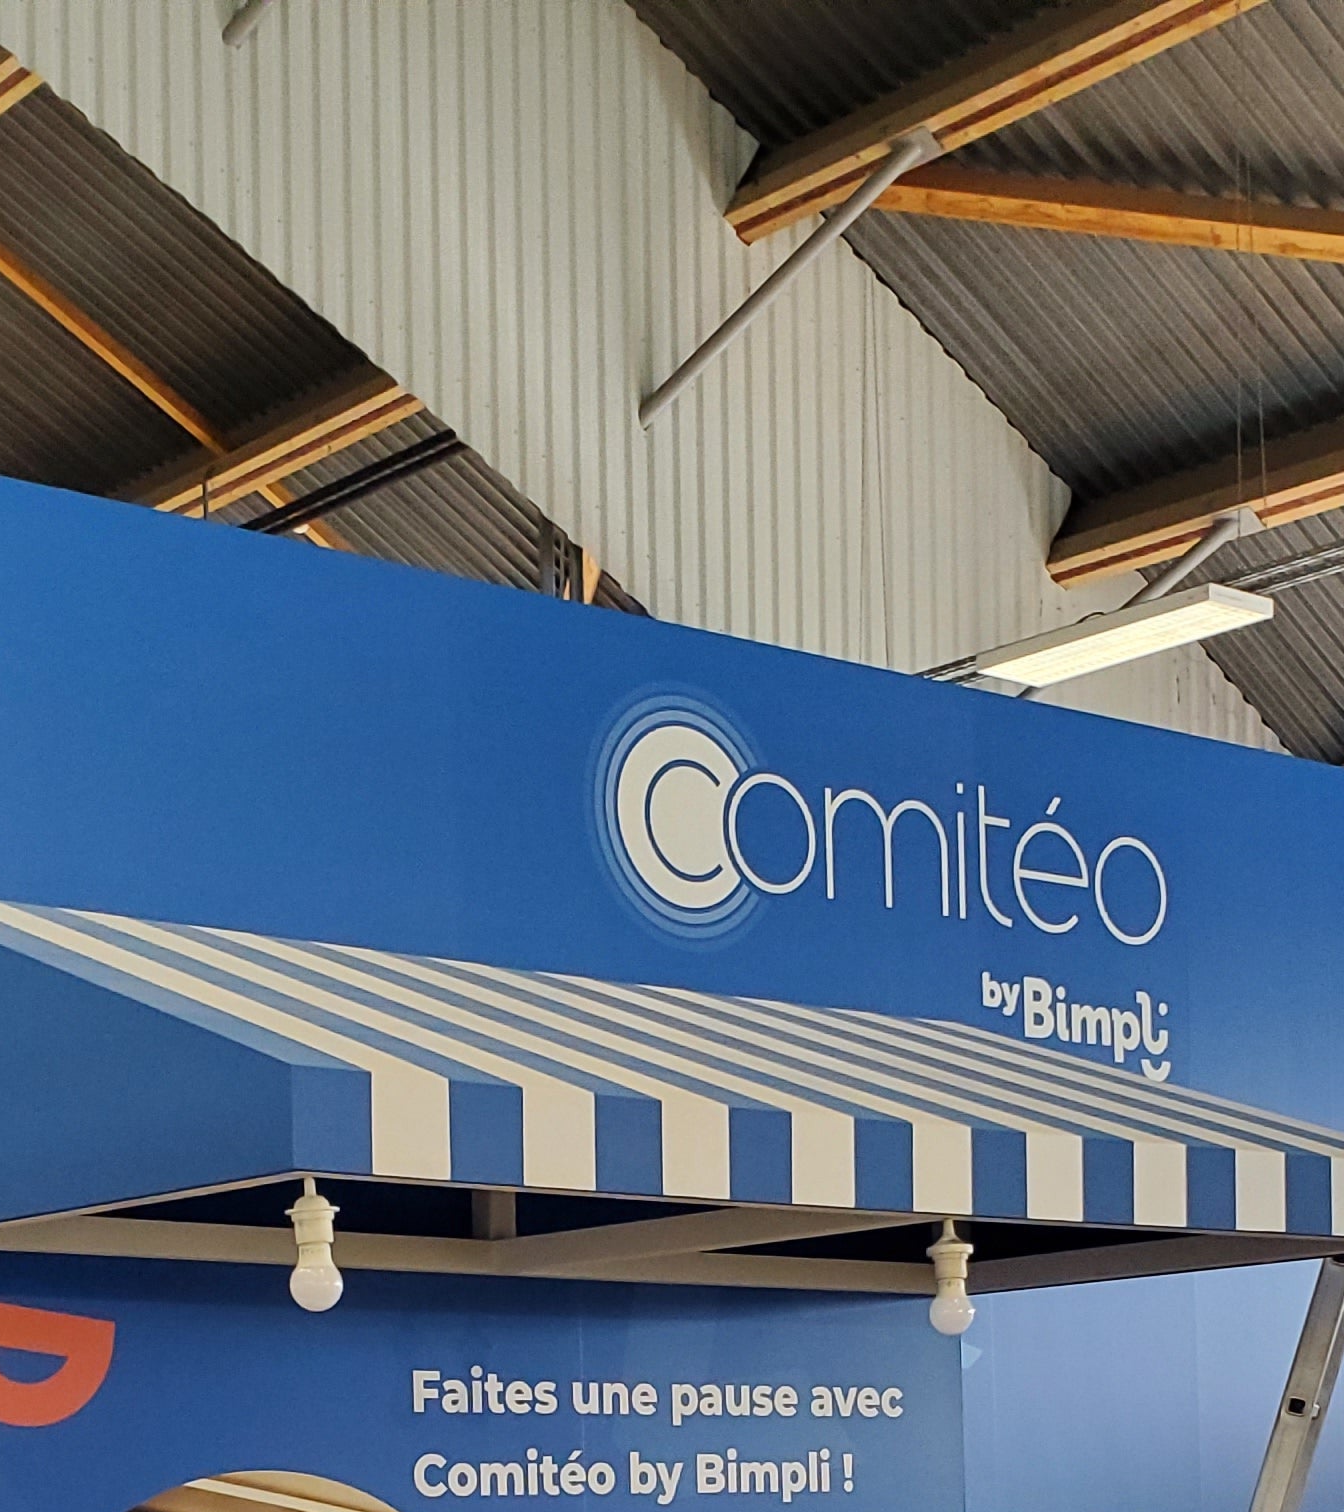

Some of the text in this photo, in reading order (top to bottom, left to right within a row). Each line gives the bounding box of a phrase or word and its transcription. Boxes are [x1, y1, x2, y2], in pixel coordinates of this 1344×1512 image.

[601, 712, 1167, 946] Comitéo
[982, 972, 1021, 1015] by
[411, 1365, 905, 1426] Faites une pause avec
[413, 1449, 616, 1498] Comitéo
[628, 1451, 684, 1506] by
[695, 1448, 831, 1504] Bimpli
